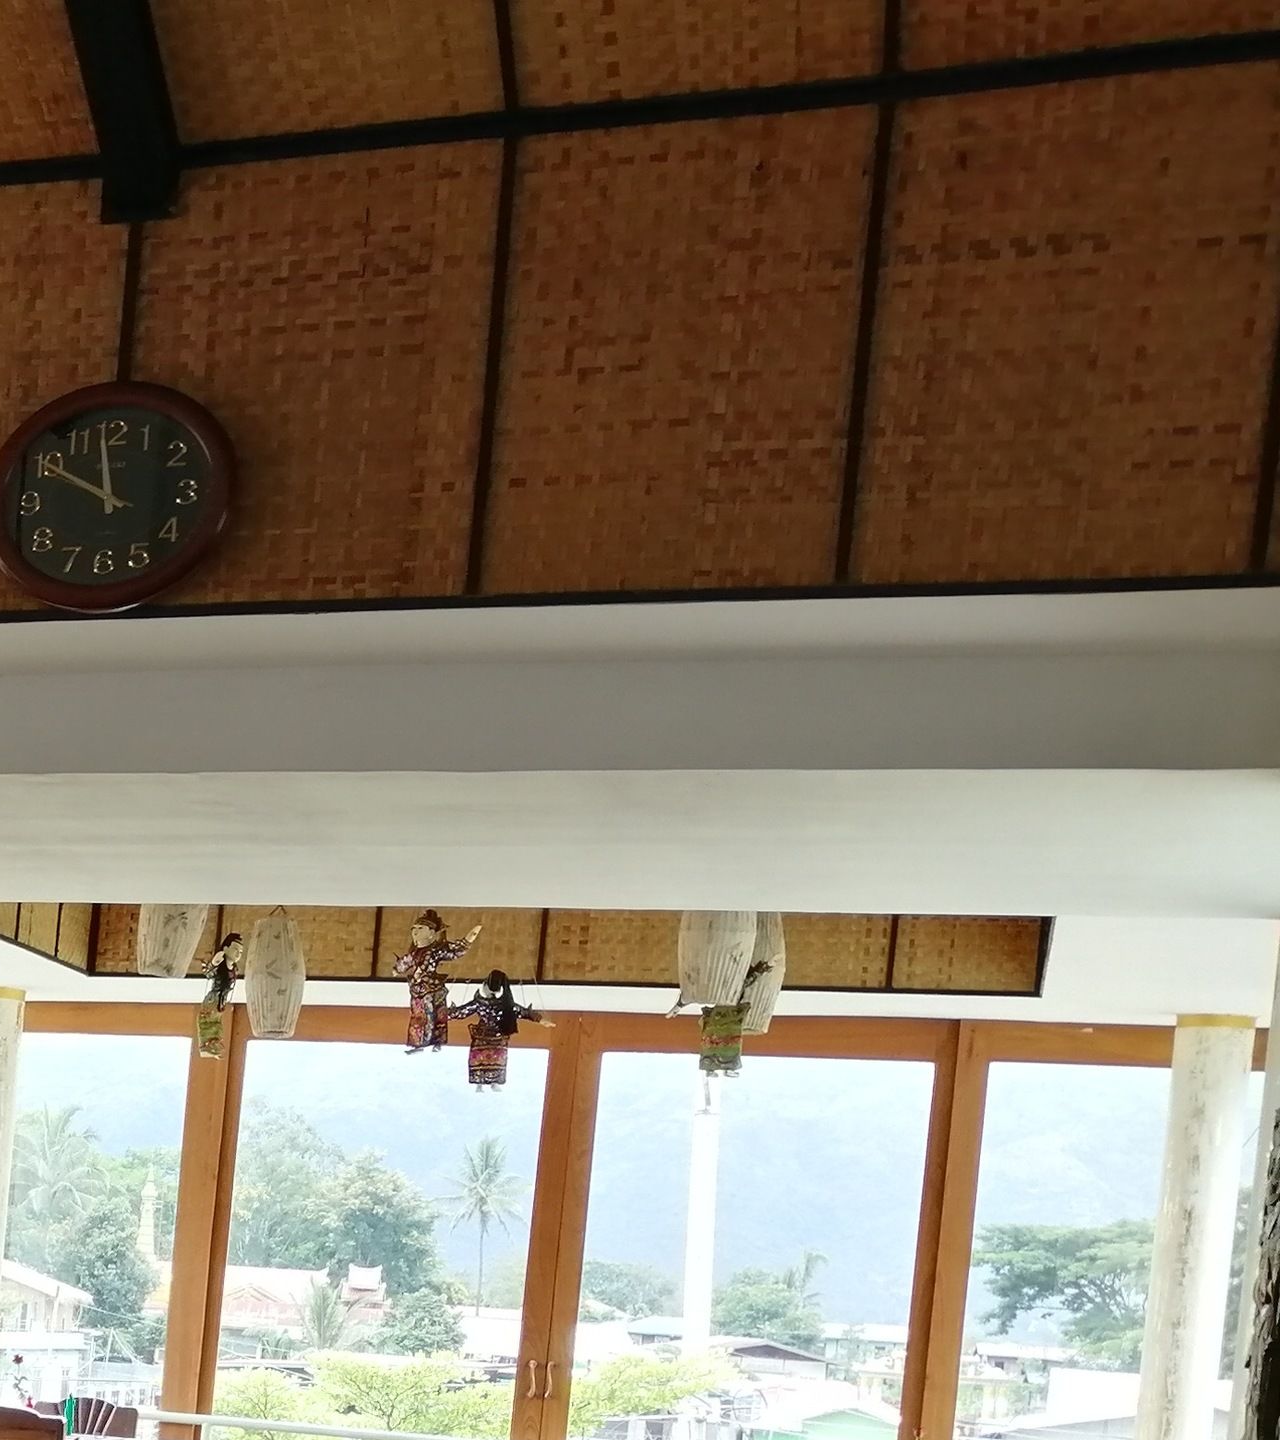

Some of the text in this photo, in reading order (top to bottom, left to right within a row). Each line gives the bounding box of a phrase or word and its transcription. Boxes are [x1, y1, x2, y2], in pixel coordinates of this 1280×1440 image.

[67, 428, 90, 455] 11
[97, 420, 128, 446] 12
[140, 424, 150, 451] 1
[34, 451, 64, 479] 10
[166, 440, 188, 467] 2
[20, 491, 41, 516] 9
[175, 479, 198, 505] 3
[32, 526, 53, 552] 8
[158, 516, 180, 543] 4
[60, 546, 82, 573] 7
[93, 550, 115, 575] 6
[128, 543, 151, 568] 5
